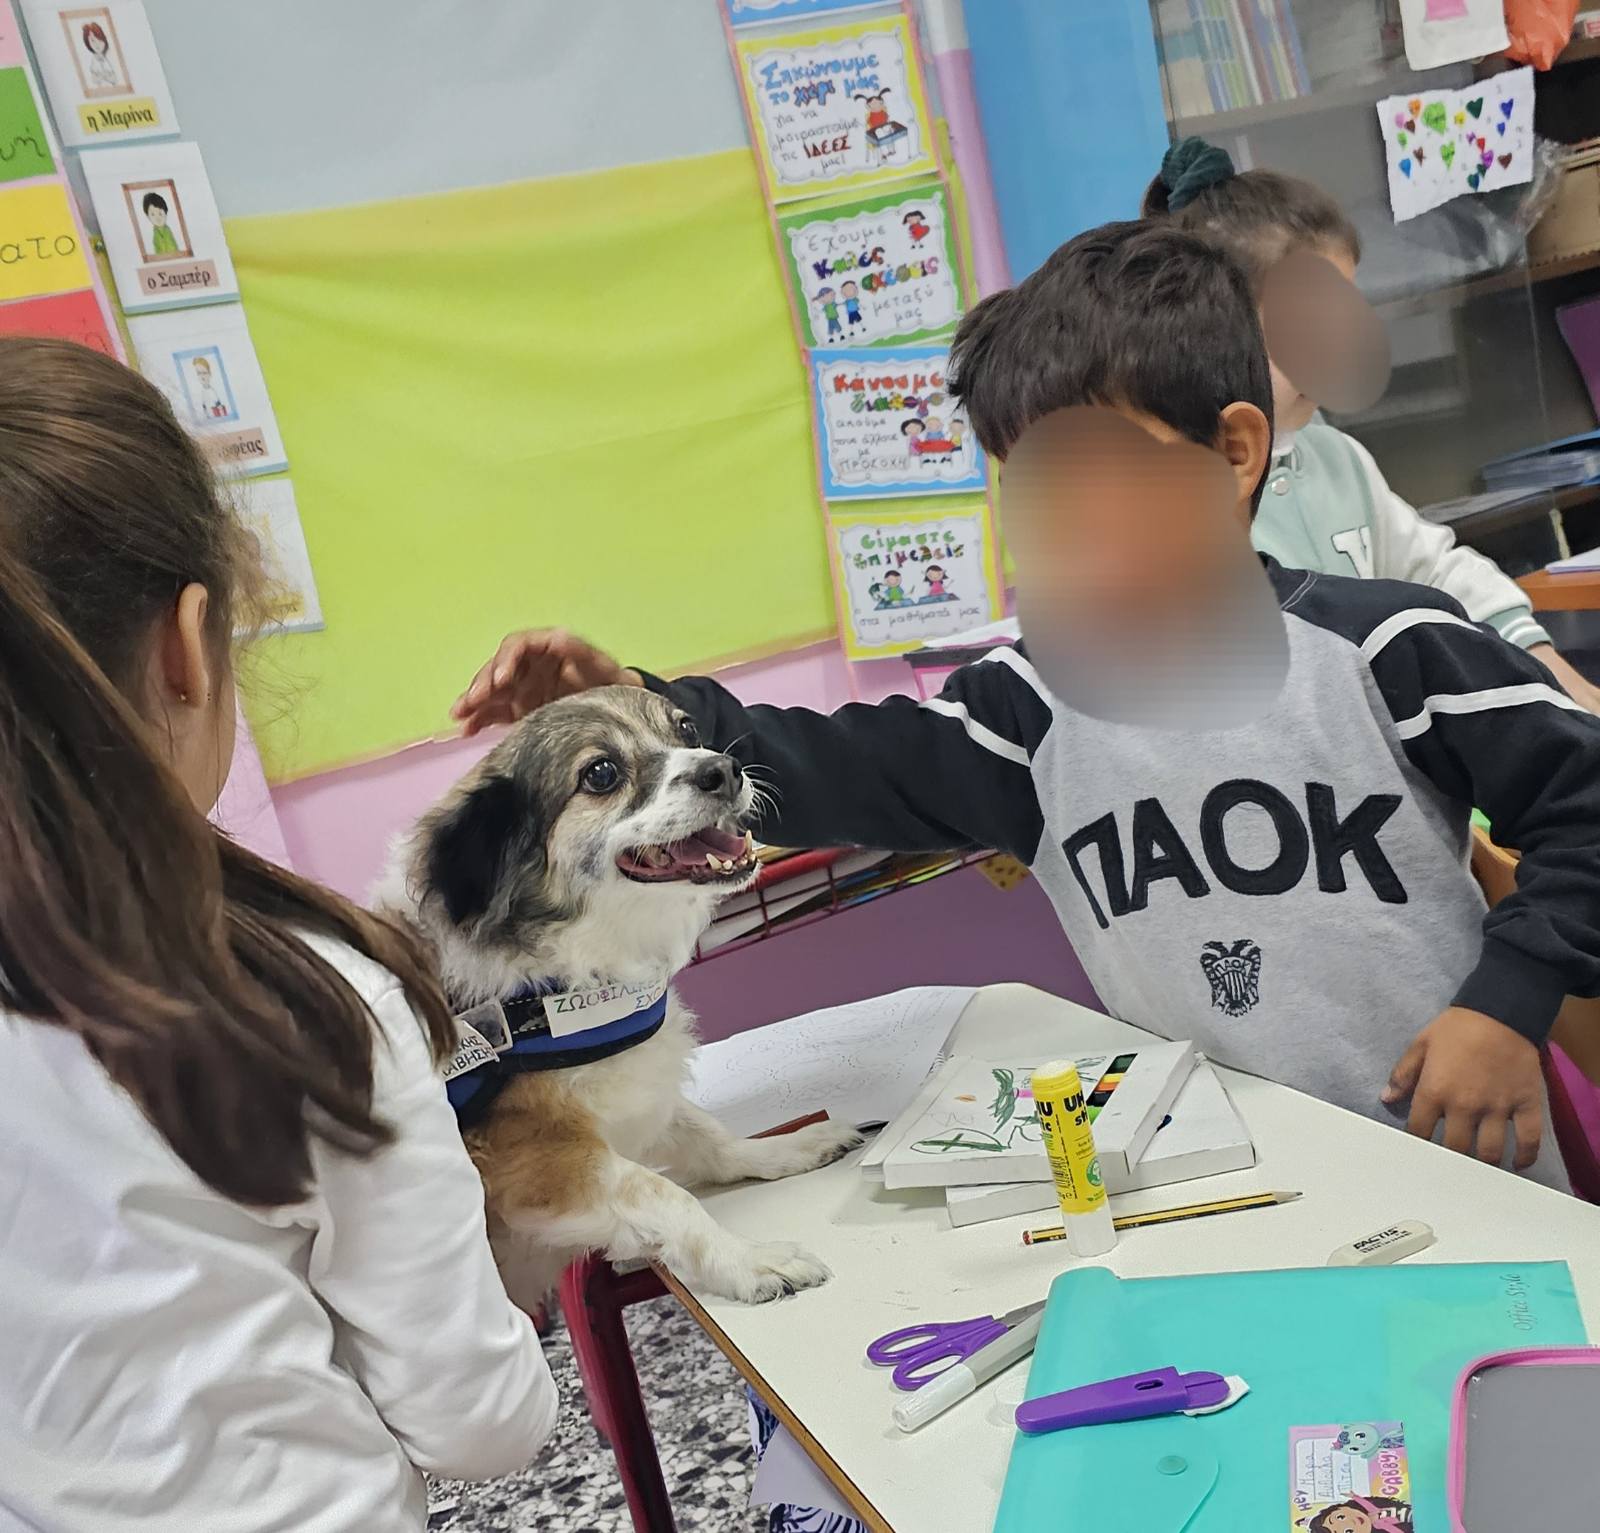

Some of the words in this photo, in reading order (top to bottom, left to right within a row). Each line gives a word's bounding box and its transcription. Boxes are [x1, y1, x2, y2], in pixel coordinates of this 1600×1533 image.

[769, 91, 789, 105] το
[87, 114, 99, 132] η
[99, 104, 154, 127] Μαρίνα
[773, 113, 795, 129] για
[803, 109, 818, 120] να
[147, 277, 157, 290] ο
[159, 268, 211, 289] Σαμπέρ
[872, 283, 934, 318] μεταξύ
[894, 307, 924, 328] μας
[1061, 778, 1408, 929] ΠΑΟΚ
[1353, 1226, 1398, 1249] FACTIS
